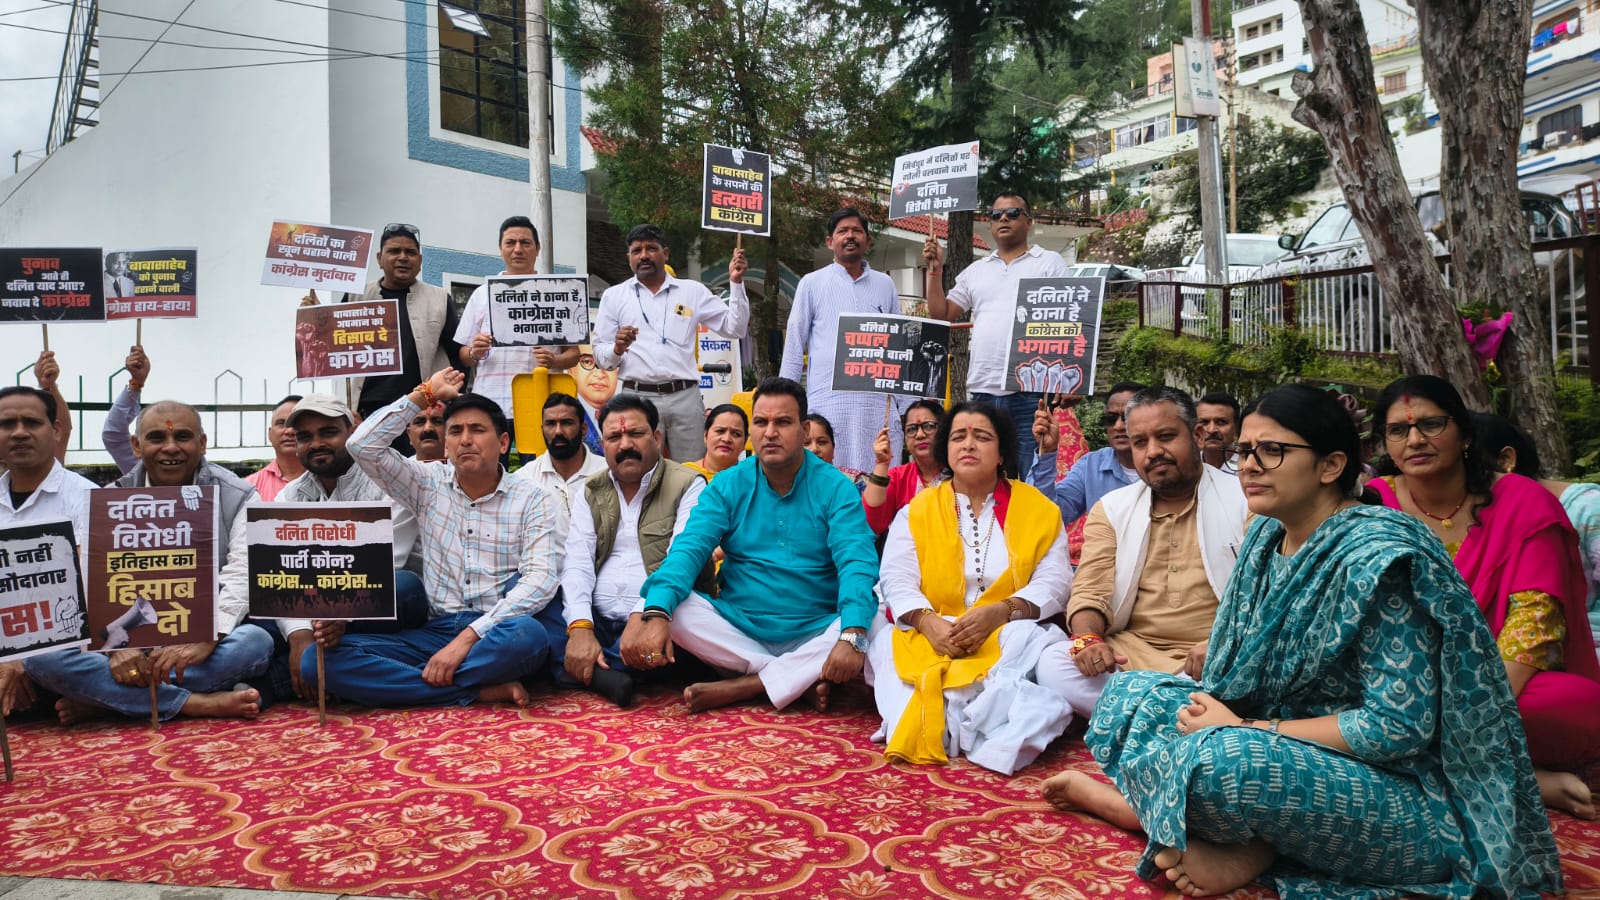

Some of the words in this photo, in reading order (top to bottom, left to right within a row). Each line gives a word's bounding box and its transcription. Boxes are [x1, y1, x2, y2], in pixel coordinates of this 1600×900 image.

[935, 152, 959, 163] दलितों
[711, 164, 764, 181] बाबासाहेब
[712, 175, 722, 186] के
[723, 178, 749, 191] सपनों
[750, 181, 763, 193] की
[916, 181, 948, 198] दलित
[711, 189, 763, 211] हत्यारी
[718, 207, 756, 224] कांग्रेस
[294, 232, 330, 248] दलितों
[330, 238, 346, 249] का
[278, 244, 301, 258] खून
[302, 247, 331, 259] बहाने
[332, 250, 357, 262] वाली
[20, 257, 60, 275] चुनाव
[129, 257, 187, 271] बाबासाहेब
[271, 261, 310, 278] कांग्रेस
[311, 267, 357, 283] मुर्दाबाद
[41, 270, 59, 281] आते
[60, 270, 70, 281] ही
[138, 272, 151, 281] को
[152, 273, 176, 284] चुनाव
[6, 279, 35, 291] दलित
[35, 281, 56, 291] याद
[58, 281, 85, 291] आए?
[134, 283, 158, 294] हराने
[159, 283, 181, 293] वाली
[1, 298, 31, 308] जवाब
[31, 295, 41, 308] दे
[41, 290, 92, 308] कांग्रेस
[495, 290, 529, 303] दलितों
[529, 289, 543, 303] ने
[543, 292, 570, 302] ठाना
[571, 288, 583, 304] है,
[1026, 285, 1076, 305] दलितों
[1076, 285, 1092, 303] ने
[332, 306, 376, 319] बाबासाहेब
[376, 305, 387, 316] के
[507, 303, 556, 322] कांग्रेस
[556, 306, 571, 320] को
[1031, 307, 1067, 321] ठाना
[1068, 301, 1082, 322] है
[336, 318, 370, 329] अपमान
[371, 317, 384, 326] का
[513, 323, 553, 334] भगाना
[554, 320, 563, 333] है
[859, 321, 889, 333] दलितों
[889, 323, 900, 335] से
[1028, 323, 1061, 336] कांग्रेस
[1063, 324, 1080, 336] को
[332, 329, 375, 346] हिसाब
[376, 326, 389, 342] दे
[700, 336, 732, 352] संकल्प
[844, 331, 890, 348] चप्पल
[1017, 339, 1071, 355] भगाना
[1072, 333, 1088, 357] है
[327, 344, 396, 370] कांग्रेस
[848, 346, 885, 359] उठवाने
[886, 348, 914, 362] वाली
[843, 357, 902, 379] कांग्रेस
[106, 494, 178, 521] दलित
[111, 521, 194, 550] विरोधी
[275, 523, 310, 542] दलित
[311, 522, 357, 542] विरोधी
[13, 542, 54, 564] नहीं
[280, 549, 310, 569] पार्टी
[311, 550, 356, 569] कौन?
[109, 552, 169, 573] इतिहास
[171, 553, 195, 568] का
[106, 573, 198, 607] हिसाब
[156, 601, 192, 637] दो
